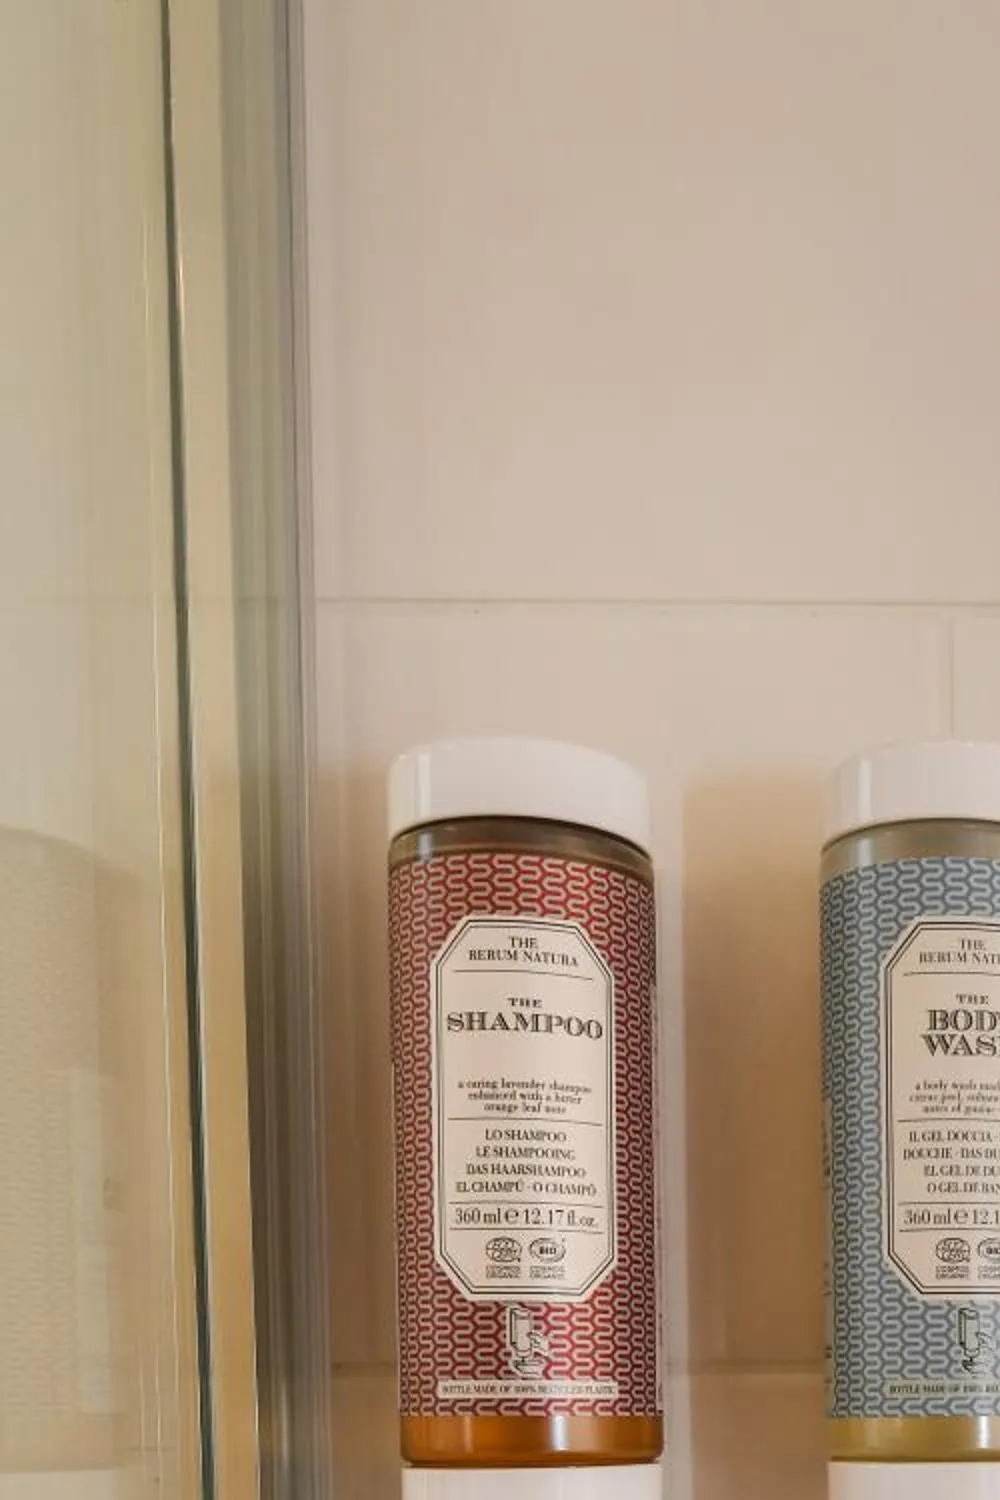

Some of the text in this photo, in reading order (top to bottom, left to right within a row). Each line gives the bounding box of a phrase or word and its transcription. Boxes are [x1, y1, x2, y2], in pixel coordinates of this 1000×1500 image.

[509, 936, 538, 949] THE
[961, 939, 986, 951] THE
[469, 949, 578, 967] RERUM NATURA
[919, 951, 967, 963] RERUM
[507, 997, 543, 1008] THE
[956, 994, 989, 1005] THE
[446, 1011, 603, 1039] SHAMPOO
[466, 1079, 498, 1090] caring
[501, 1078, 546, 1090] lavender
[550, 1080, 592, 1094] shampoo
[520, 1090, 543, 1101] with
[485, 1128, 567, 1142] LO SHAMPOO
[476, 1146, 576, 1160] LE SHAMPOOING
[466, 1164, 587, 1178] DAS HAARSHAMPOO
[456, 1182, 471, 1193] EL
[455, 1207, 481, 1224] 360
[484, 1207, 500, 1224] ml
[524, 1208, 565, 1226] 12.17
[903, 1208, 931, 1225] 360
[933, 1208, 951, 1225] ml
